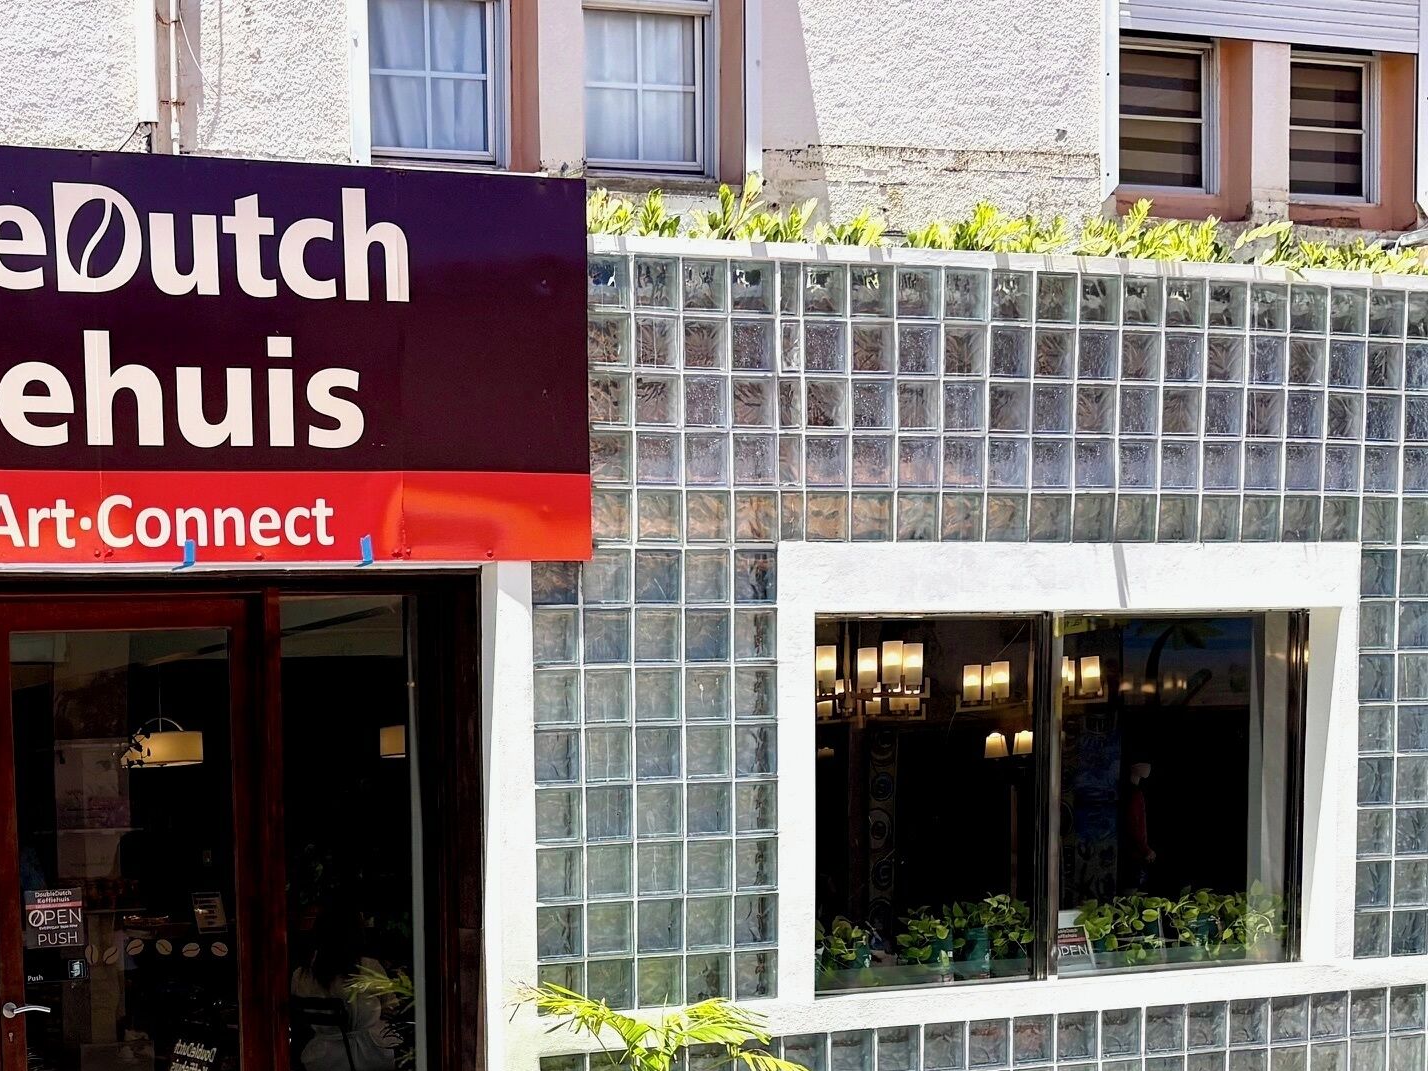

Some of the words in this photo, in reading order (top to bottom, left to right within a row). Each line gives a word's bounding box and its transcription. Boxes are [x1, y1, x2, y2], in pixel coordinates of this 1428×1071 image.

[28, 907, 82, 927] OPEN
[37, 931, 78, 946] PUSH
[1058, 942, 1089, 957] PEN
[27, 974, 44, 982] Push
